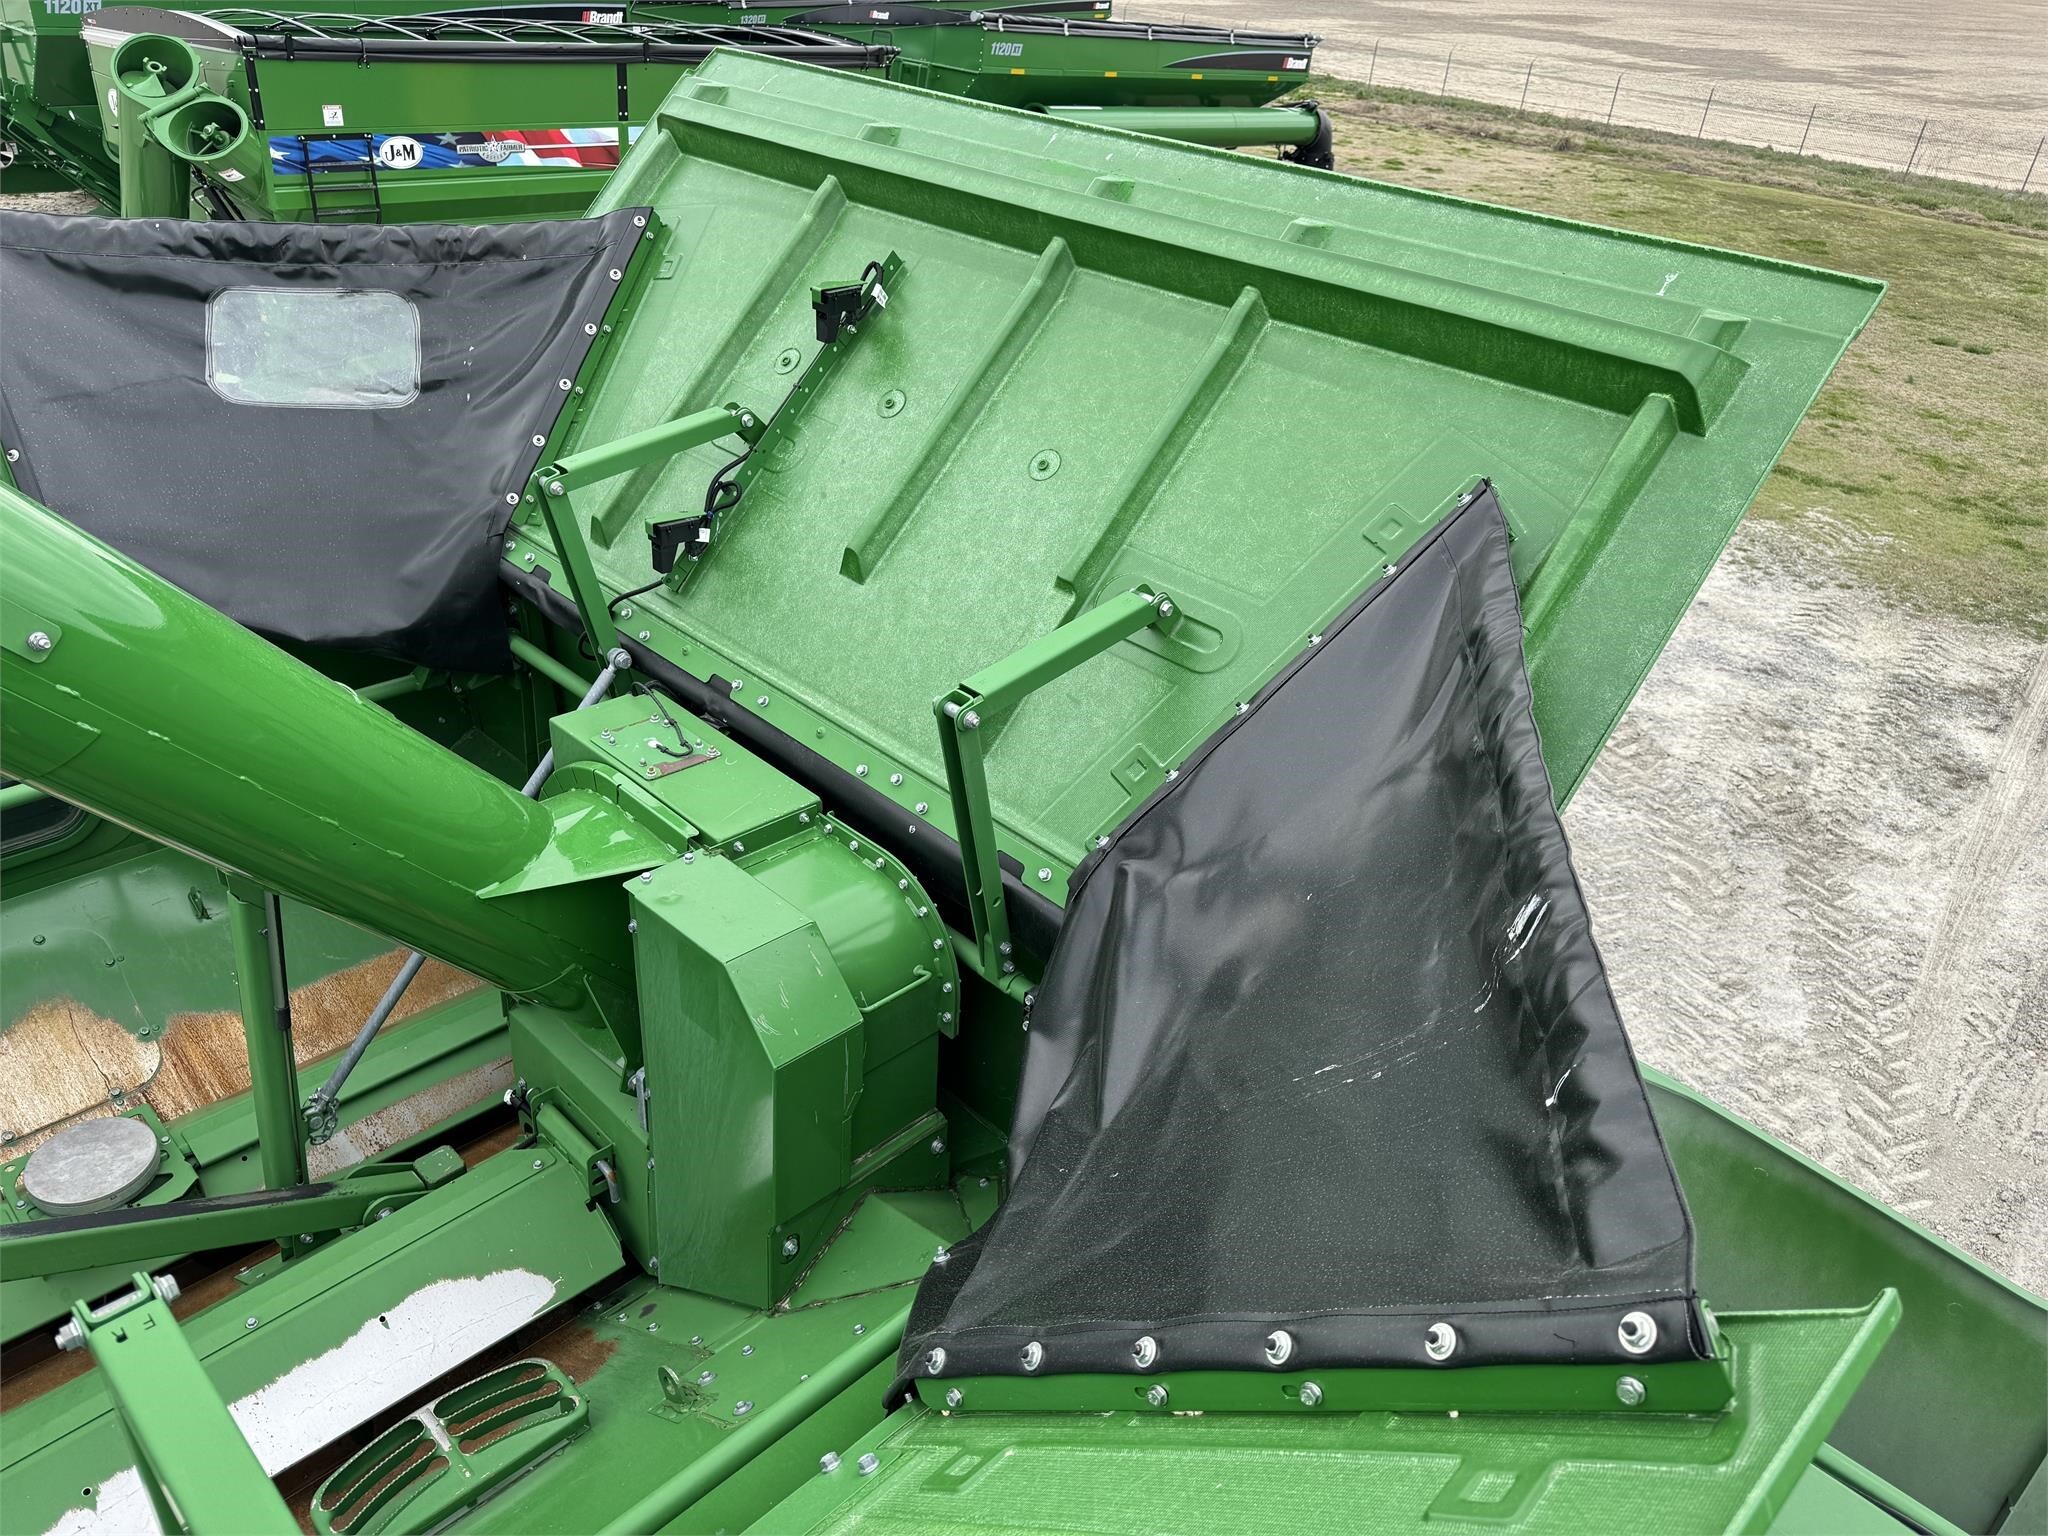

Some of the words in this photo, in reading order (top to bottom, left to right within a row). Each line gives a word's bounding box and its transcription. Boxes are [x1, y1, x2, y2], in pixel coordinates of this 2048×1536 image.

[44, 0, 81, 14] 1120
[590, 11, 624, 24] Brandt
[991, 41, 1012, 56] 1120
[385, 143, 416, 162] J&M
